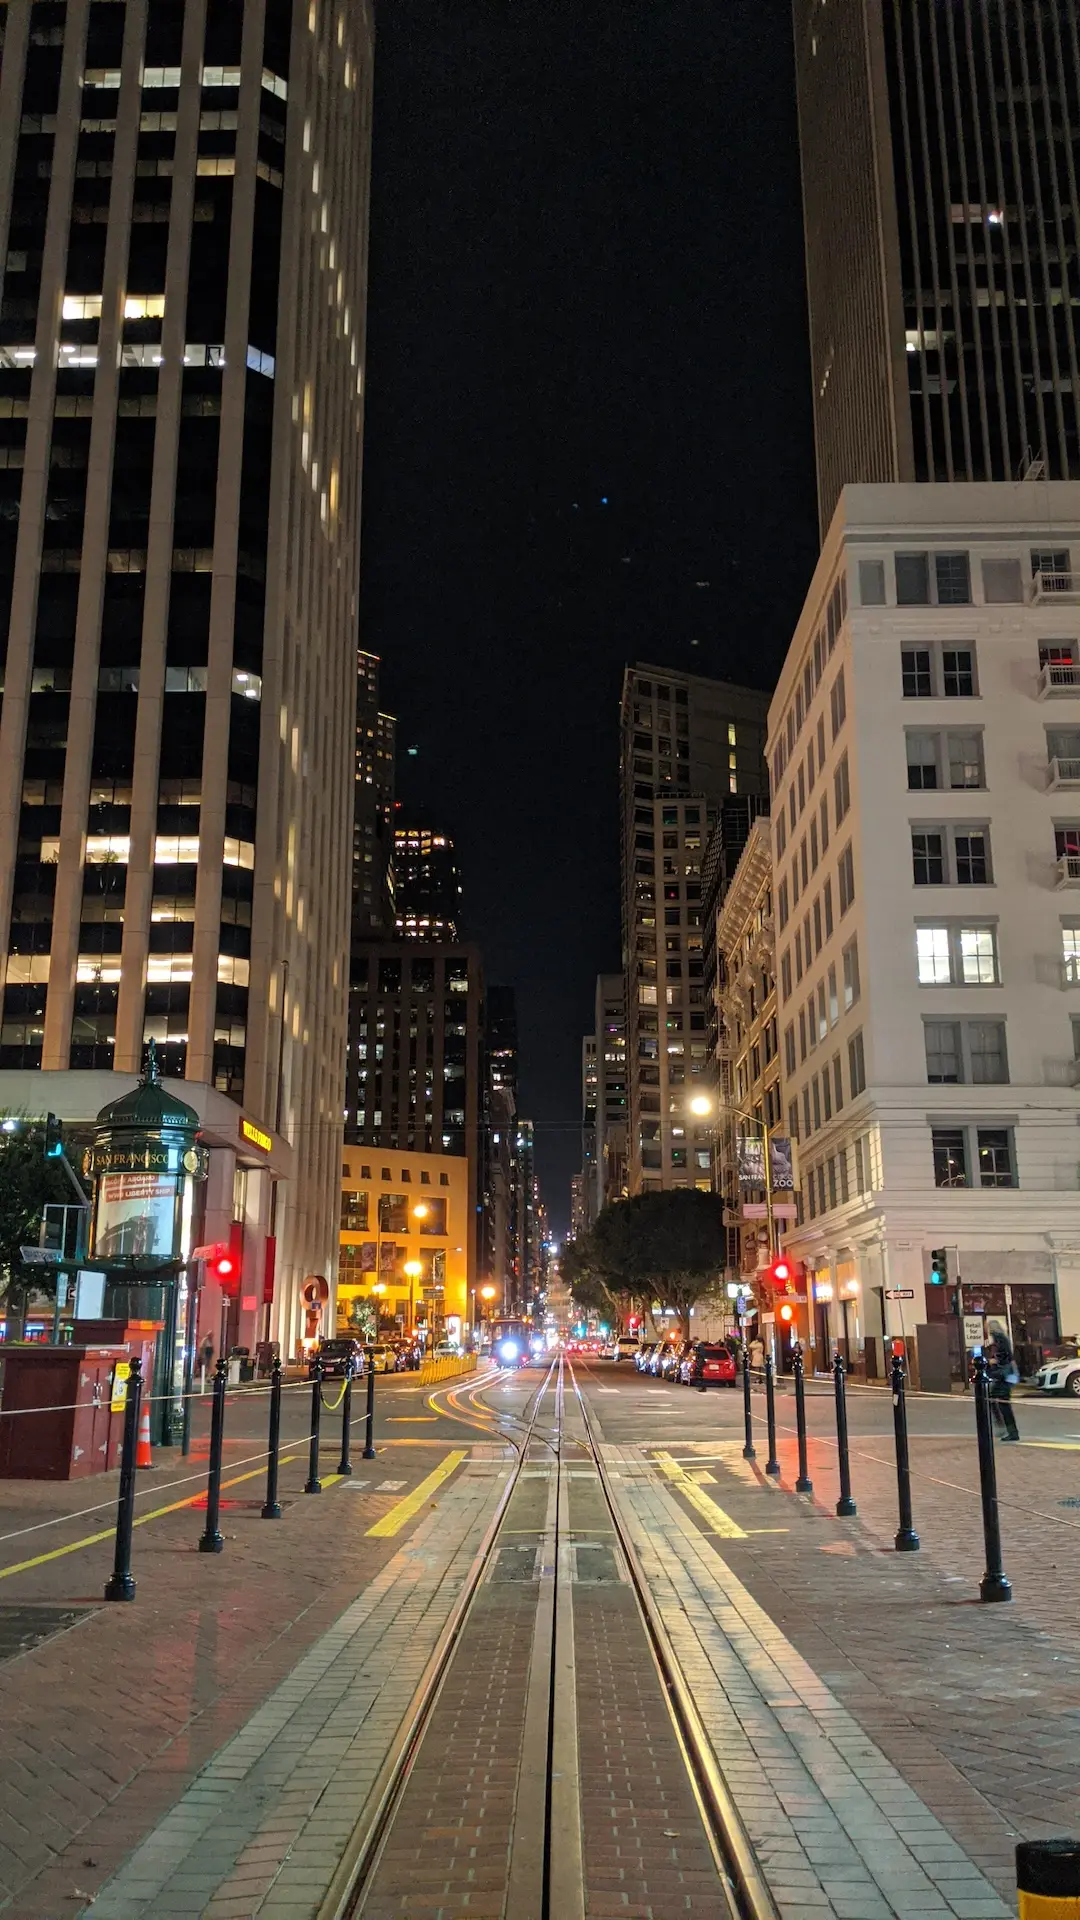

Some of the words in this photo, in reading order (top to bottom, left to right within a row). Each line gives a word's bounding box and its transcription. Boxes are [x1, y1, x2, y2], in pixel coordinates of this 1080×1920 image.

[96, 1154, 113, 1166] SAN
[114, 1153, 168, 1165] FRANCISCO
[125, 1188, 154, 1198] LIBERTY
[155, 1187, 171, 1195] SHIP
